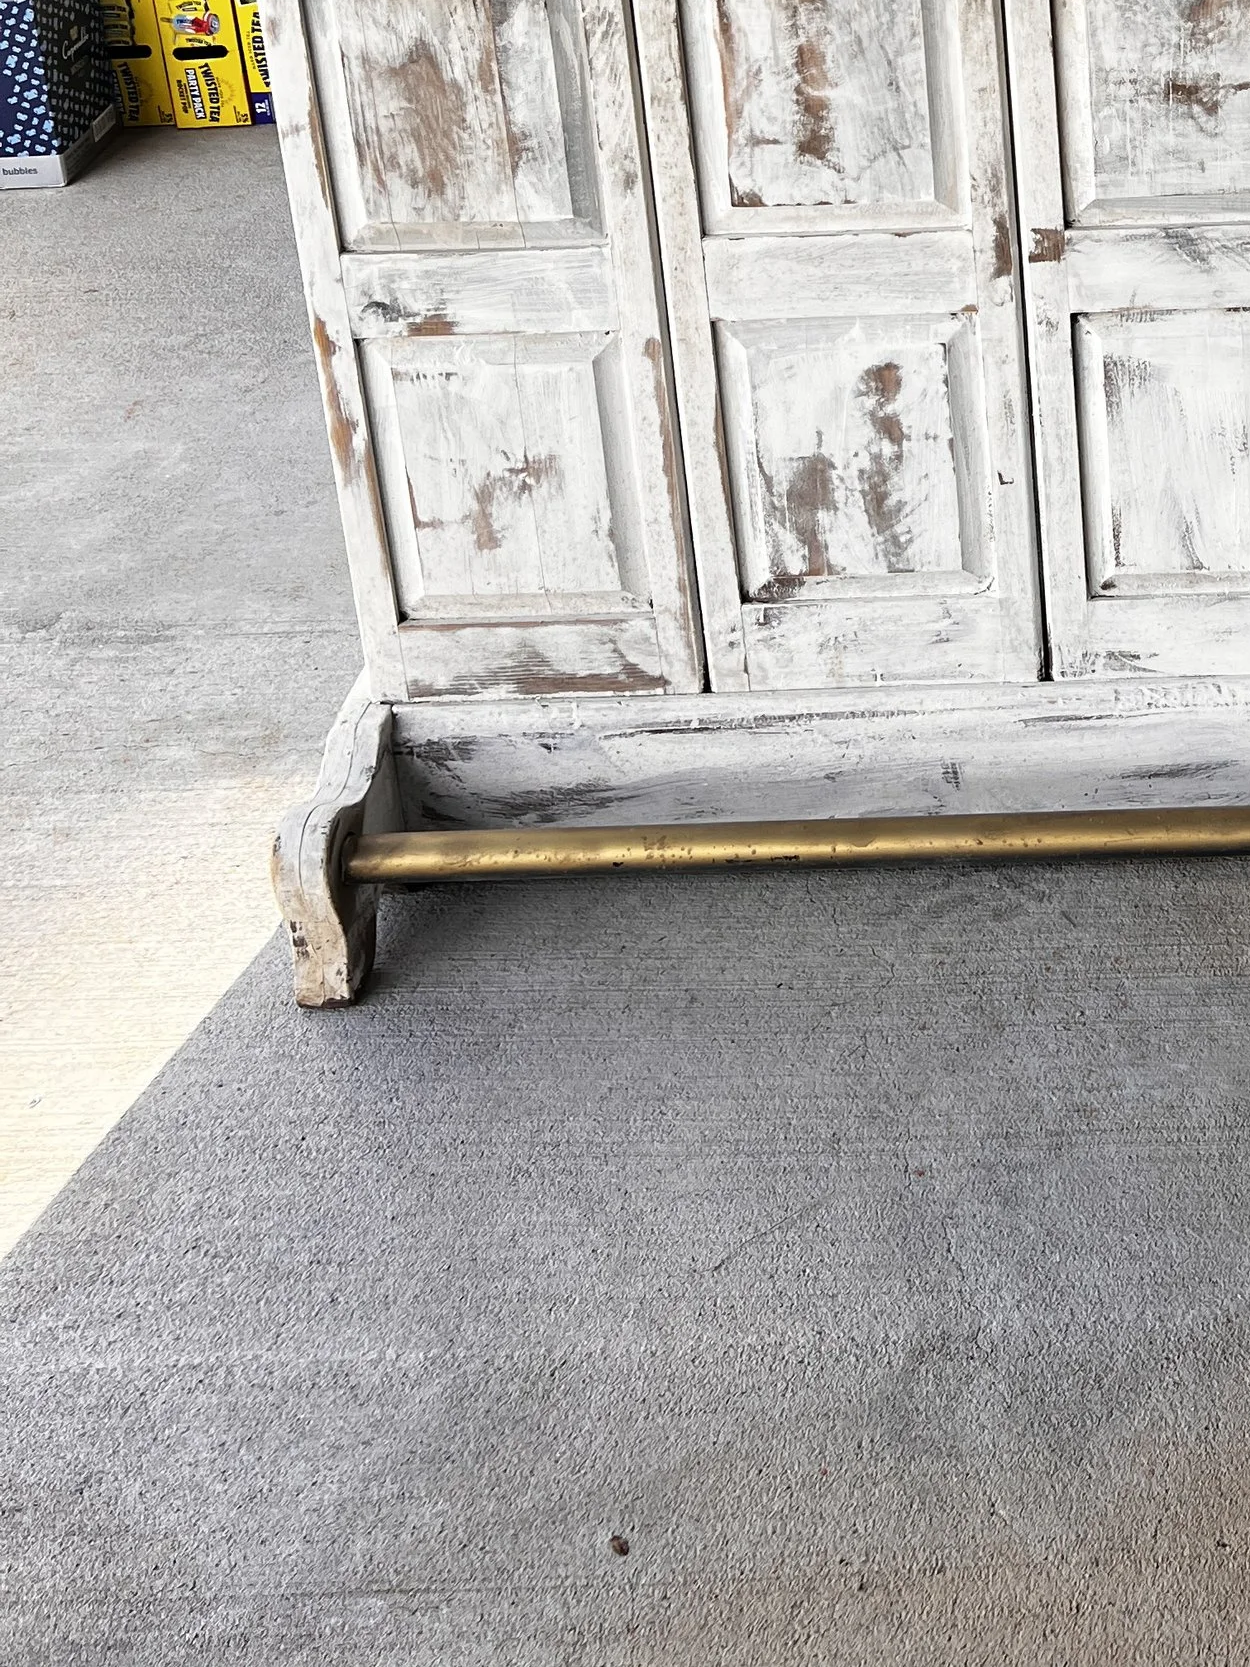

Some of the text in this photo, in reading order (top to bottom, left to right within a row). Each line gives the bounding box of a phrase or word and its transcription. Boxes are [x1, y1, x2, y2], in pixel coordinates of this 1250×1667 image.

[117, 61, 139, 104] TWISTED
[185, 69, 200, 97] PARTY
[198, 63, 220, 104] TWISTED
[209, 105, 221, 123] TEA
[127, 104, 140, 122] TEA
[192, 97, 206, 119] PACK
[255, 101, 266, 114] 12
[2, 166, 38, 176] bubbles
